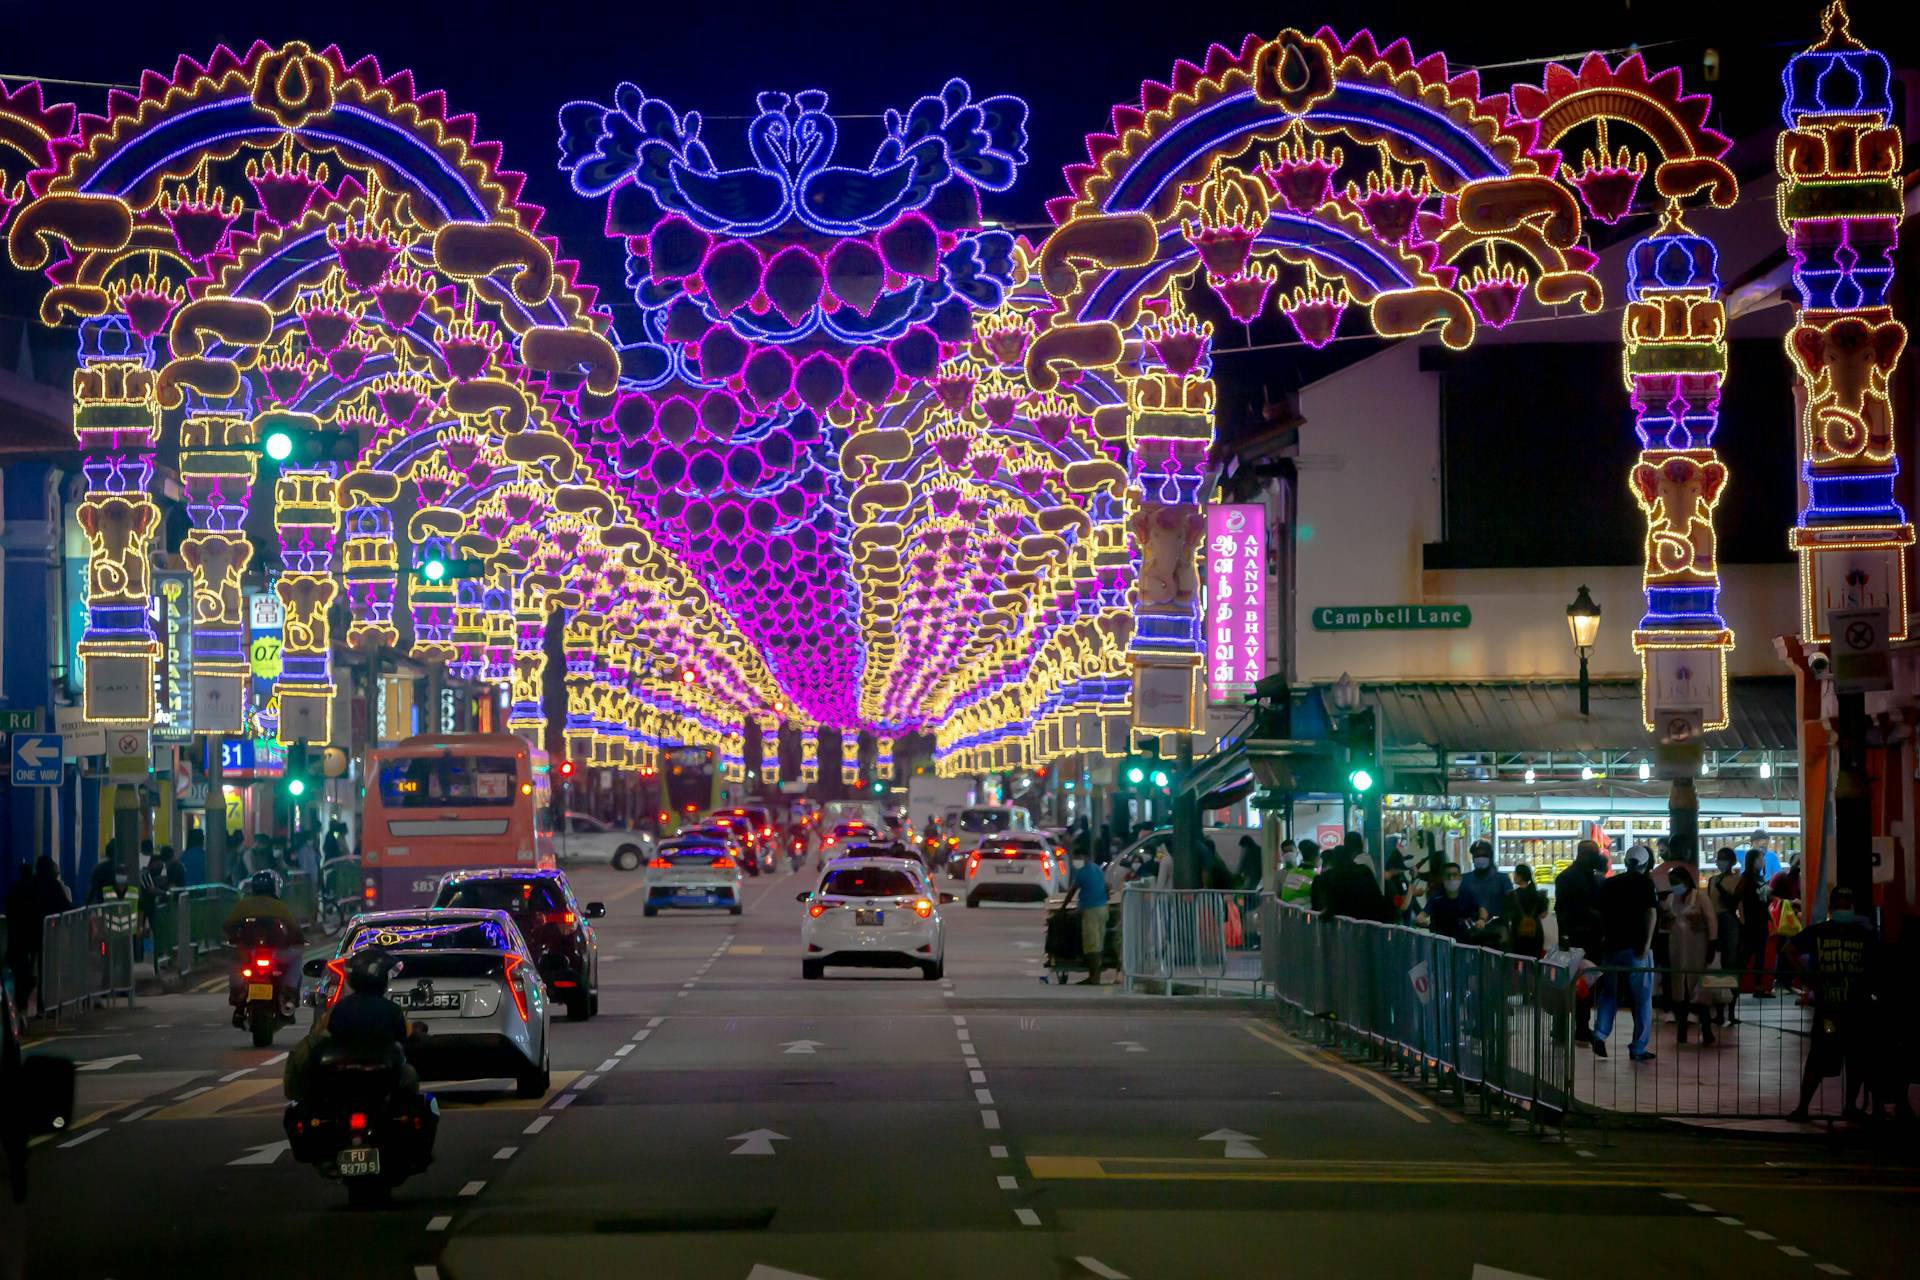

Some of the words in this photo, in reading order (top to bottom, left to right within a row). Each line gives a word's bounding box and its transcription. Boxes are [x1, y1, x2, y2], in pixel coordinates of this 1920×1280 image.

[1244, 534, 1259, 606] ANANDA
[1322, 608, 1410, 627] Campbell
[1417, 608, 1462, 623] Lane
[1244, 610, 1259, 682] BHAVAN
[10, 713, 31, 729] Rd
[16, 770, 36, 781] ONE
[40, 770, 59, 780] WAY
[411, 880, 435, 893] SBS
[351, 1151, 365, 1162] FU
